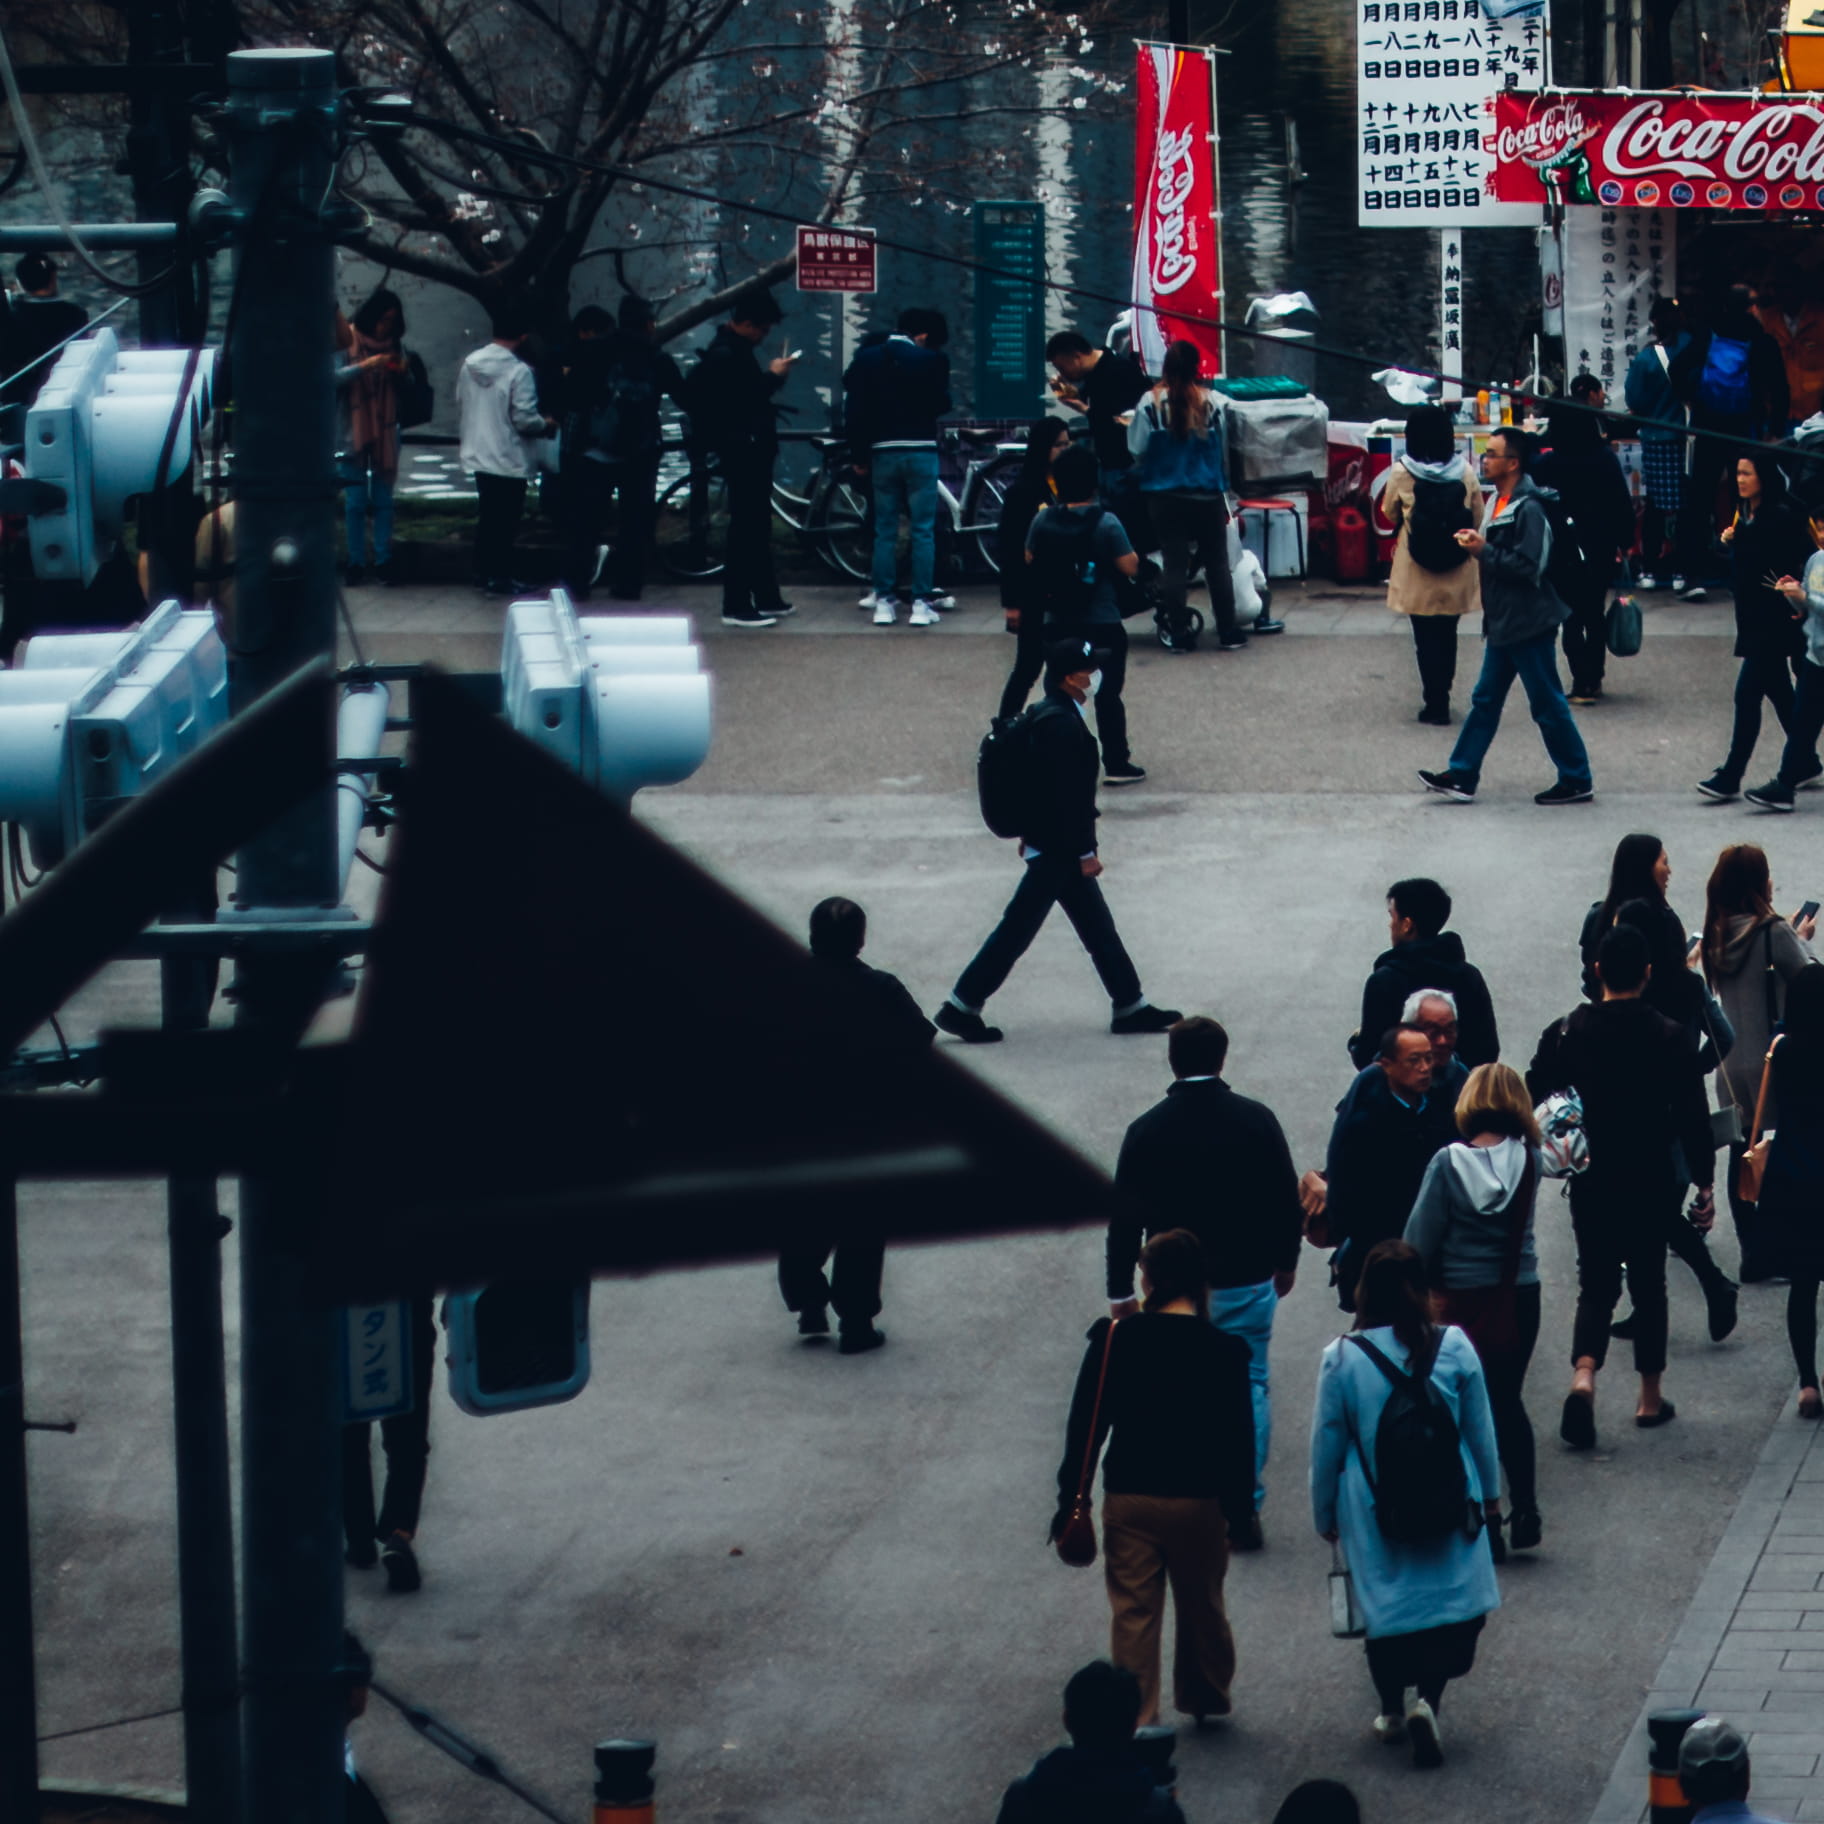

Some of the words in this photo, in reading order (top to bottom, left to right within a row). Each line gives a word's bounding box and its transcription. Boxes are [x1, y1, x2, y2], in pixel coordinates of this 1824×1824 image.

[1362, 101, 1383, 210] 十二月十日
[1382, 101, 1403, 210] 十一月四日
[1402, 102, 1422, 209] 十月十一日
[1423, 102, 1441, 209] 九月五日
[1443, 103, 1461, 208] 八月十二日
[1462, 103, 1480, 207] 七月七日
[1498, 98, 1584, 163] Coca-Cola
[1153, 122, 1197, 295] Coca-Cola
